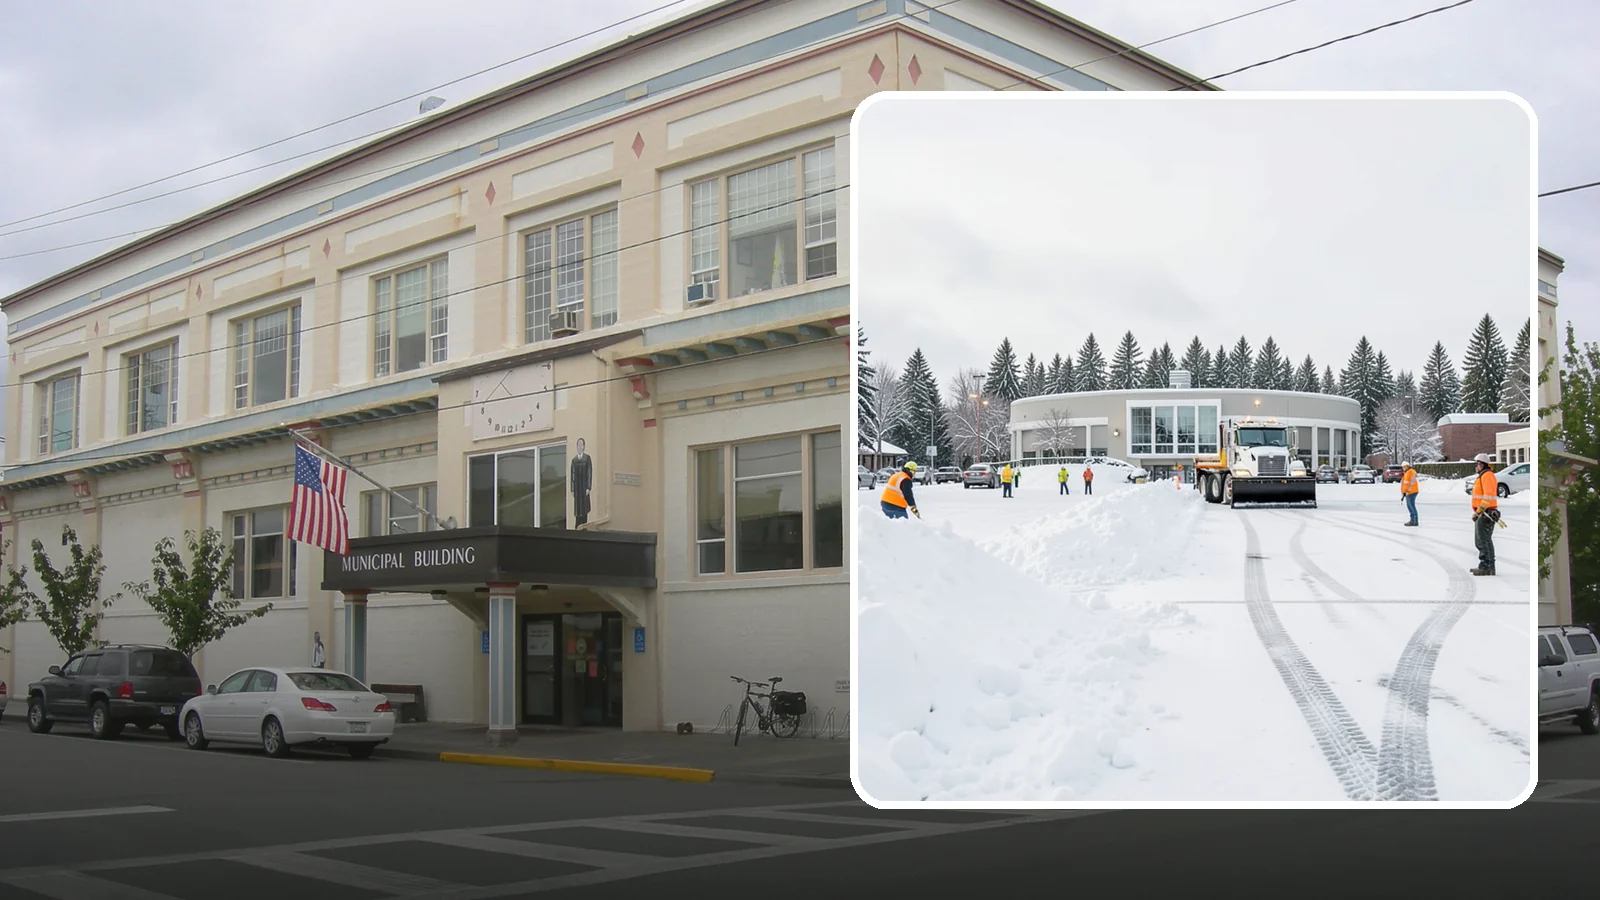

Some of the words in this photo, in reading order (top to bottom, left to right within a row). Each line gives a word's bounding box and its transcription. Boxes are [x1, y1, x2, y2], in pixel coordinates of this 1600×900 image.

[475, 390, 479, 398] 7
[481, 407, 485, 415] 8
[488, 418, 492, 426] 9
[507, 425, 513, 433] 12
[515, 424, 518, 432] 1
[521, 420, 525, 428] 2
[529, 414, 533, 422] 3
[536, 402, 540, 410] 4
[547, 361, 551, 370] 6
[342, 552, 405, 572] MUNICIPAL
[414, 546, 475, 567] BUILDING
